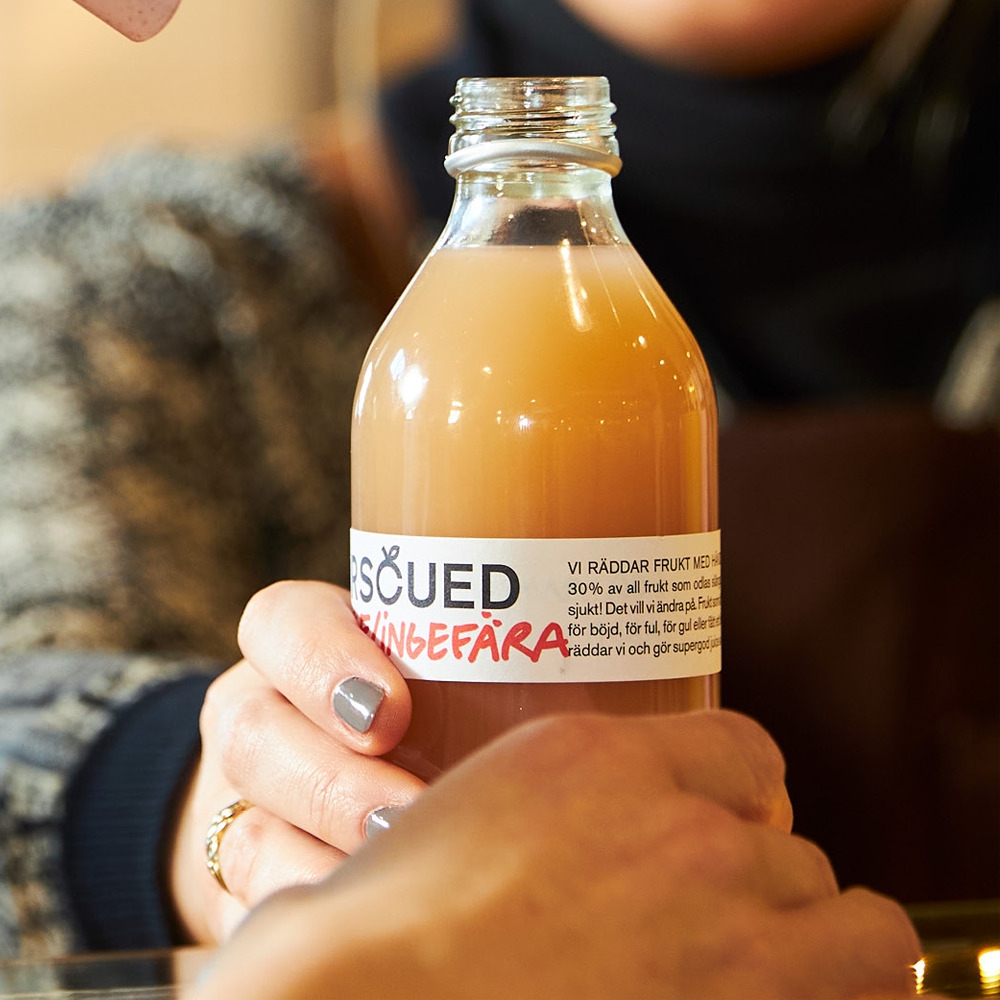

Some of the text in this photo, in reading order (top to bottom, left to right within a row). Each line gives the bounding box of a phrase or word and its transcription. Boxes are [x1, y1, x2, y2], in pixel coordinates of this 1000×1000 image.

[568, 561, 581, 575] VI
[588, 558, 649, 575] RÄDDAR
[653, 556, 691, 572] FRUKT
[693, 554, 710, 569] MED
[568, 582, 603, 596] 30%
[608, 585, 622, 594] av
[627, 580, 640, 594] all
[644, 579, 668, 594] frukt
[672, 580, 691, 592] som
[693, 576, 711, 590] odlas
[568, 602, 602, 620] sjukt!
[605, 601, 628, 615] Det
[630, 600, 645, 614] vill
[646, 600, 655, 613] vi
[656, 598, 684, 613] ändra
[568, 622, 587, 636] för
[590, 621, 622, 639] böjd,
[625, 621, 642, 634] för
[644, 620, 661, 636] ful,
[663, 619, 677, 633] för
[678, 618, 692, 636] gul
[693, 617, 708, 631] eller
[568, 643, 613, 657] räddar
[616, 642, 626, 656] vi
[628, 641, 651, 656] och
[653, 641, 671, 658] gör
[672, 637, 710, 656] supergod
